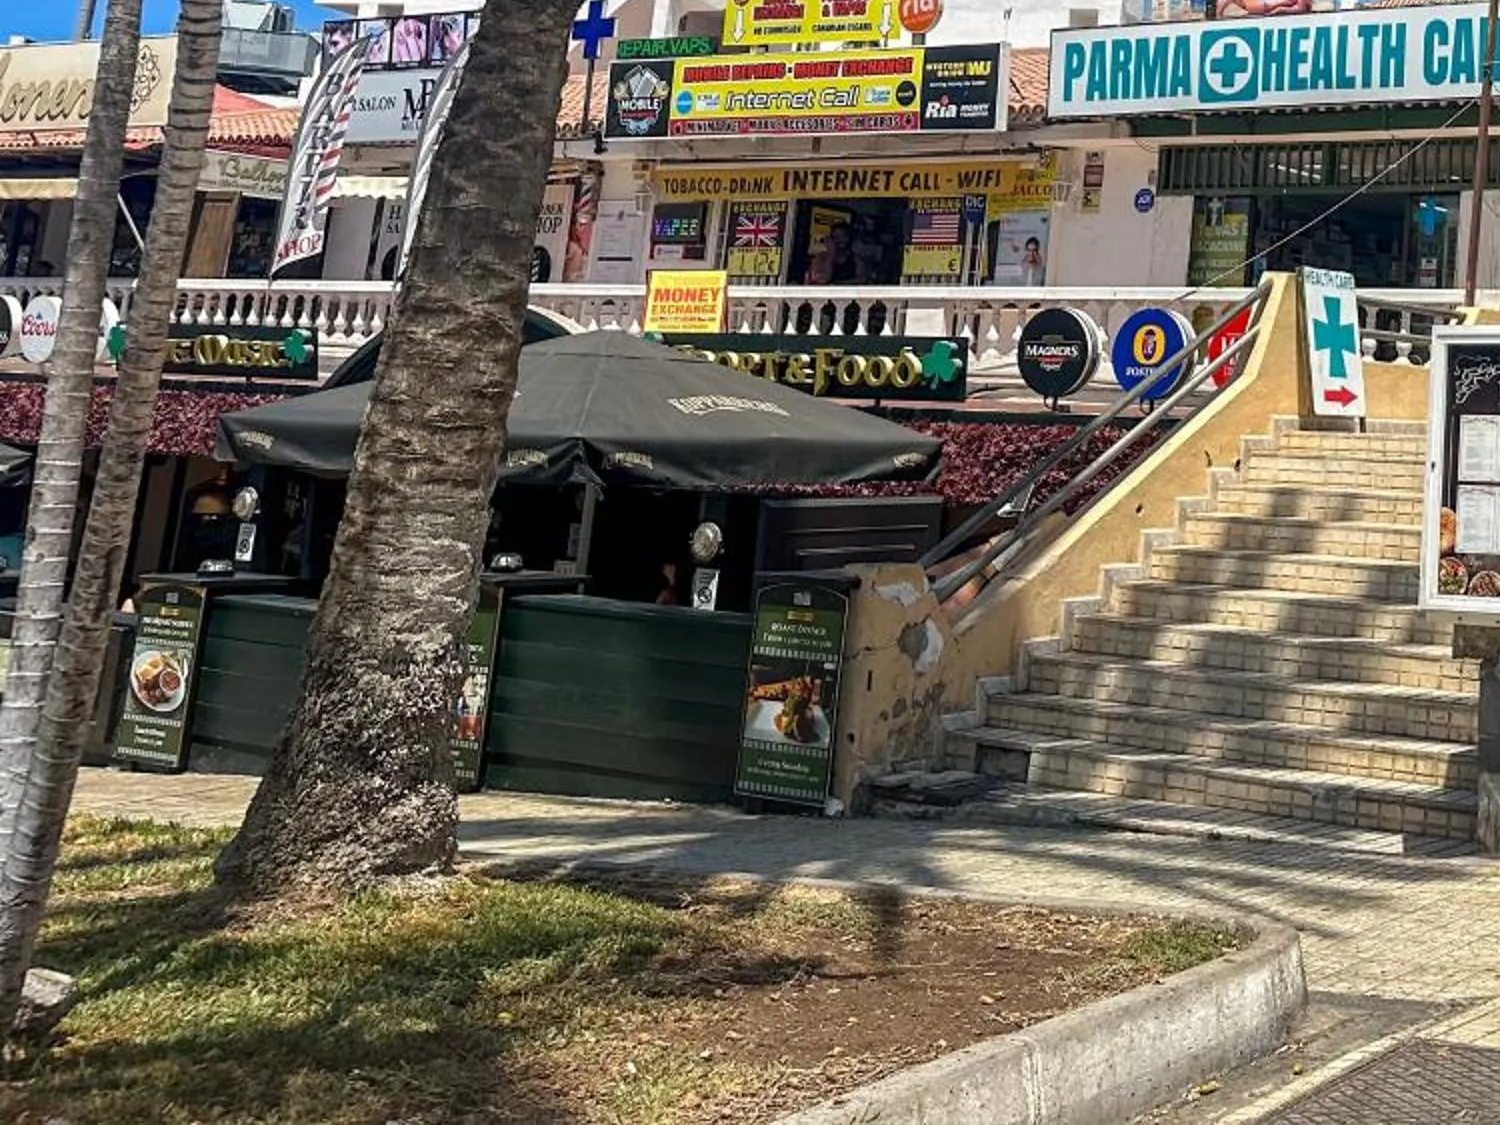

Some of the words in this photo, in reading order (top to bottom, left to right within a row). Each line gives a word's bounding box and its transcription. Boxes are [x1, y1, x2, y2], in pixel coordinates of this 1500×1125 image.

[1063, 34, 1191, 102] PARMA
[1259, 22, 1407, 91] HEALTH
[359, 96, 397, 112] SALON
[820, 85, 860, 108] Call
[925, 94, 957, 118] Ria
[664, 176, 774, 195] TOBACCO-DRINK
[783, 169, 895, 193] INTERNET
[900, 172, 940, 192] CALL
[957, 169, 1001, 189] WIFI
[653, 287, 721, 303] MONEY
[651, 304, 718, 315] EXCHANGE
[21, 314, 56, 336] Coors
[1025, 344, 1080, 358] MAGNERS
